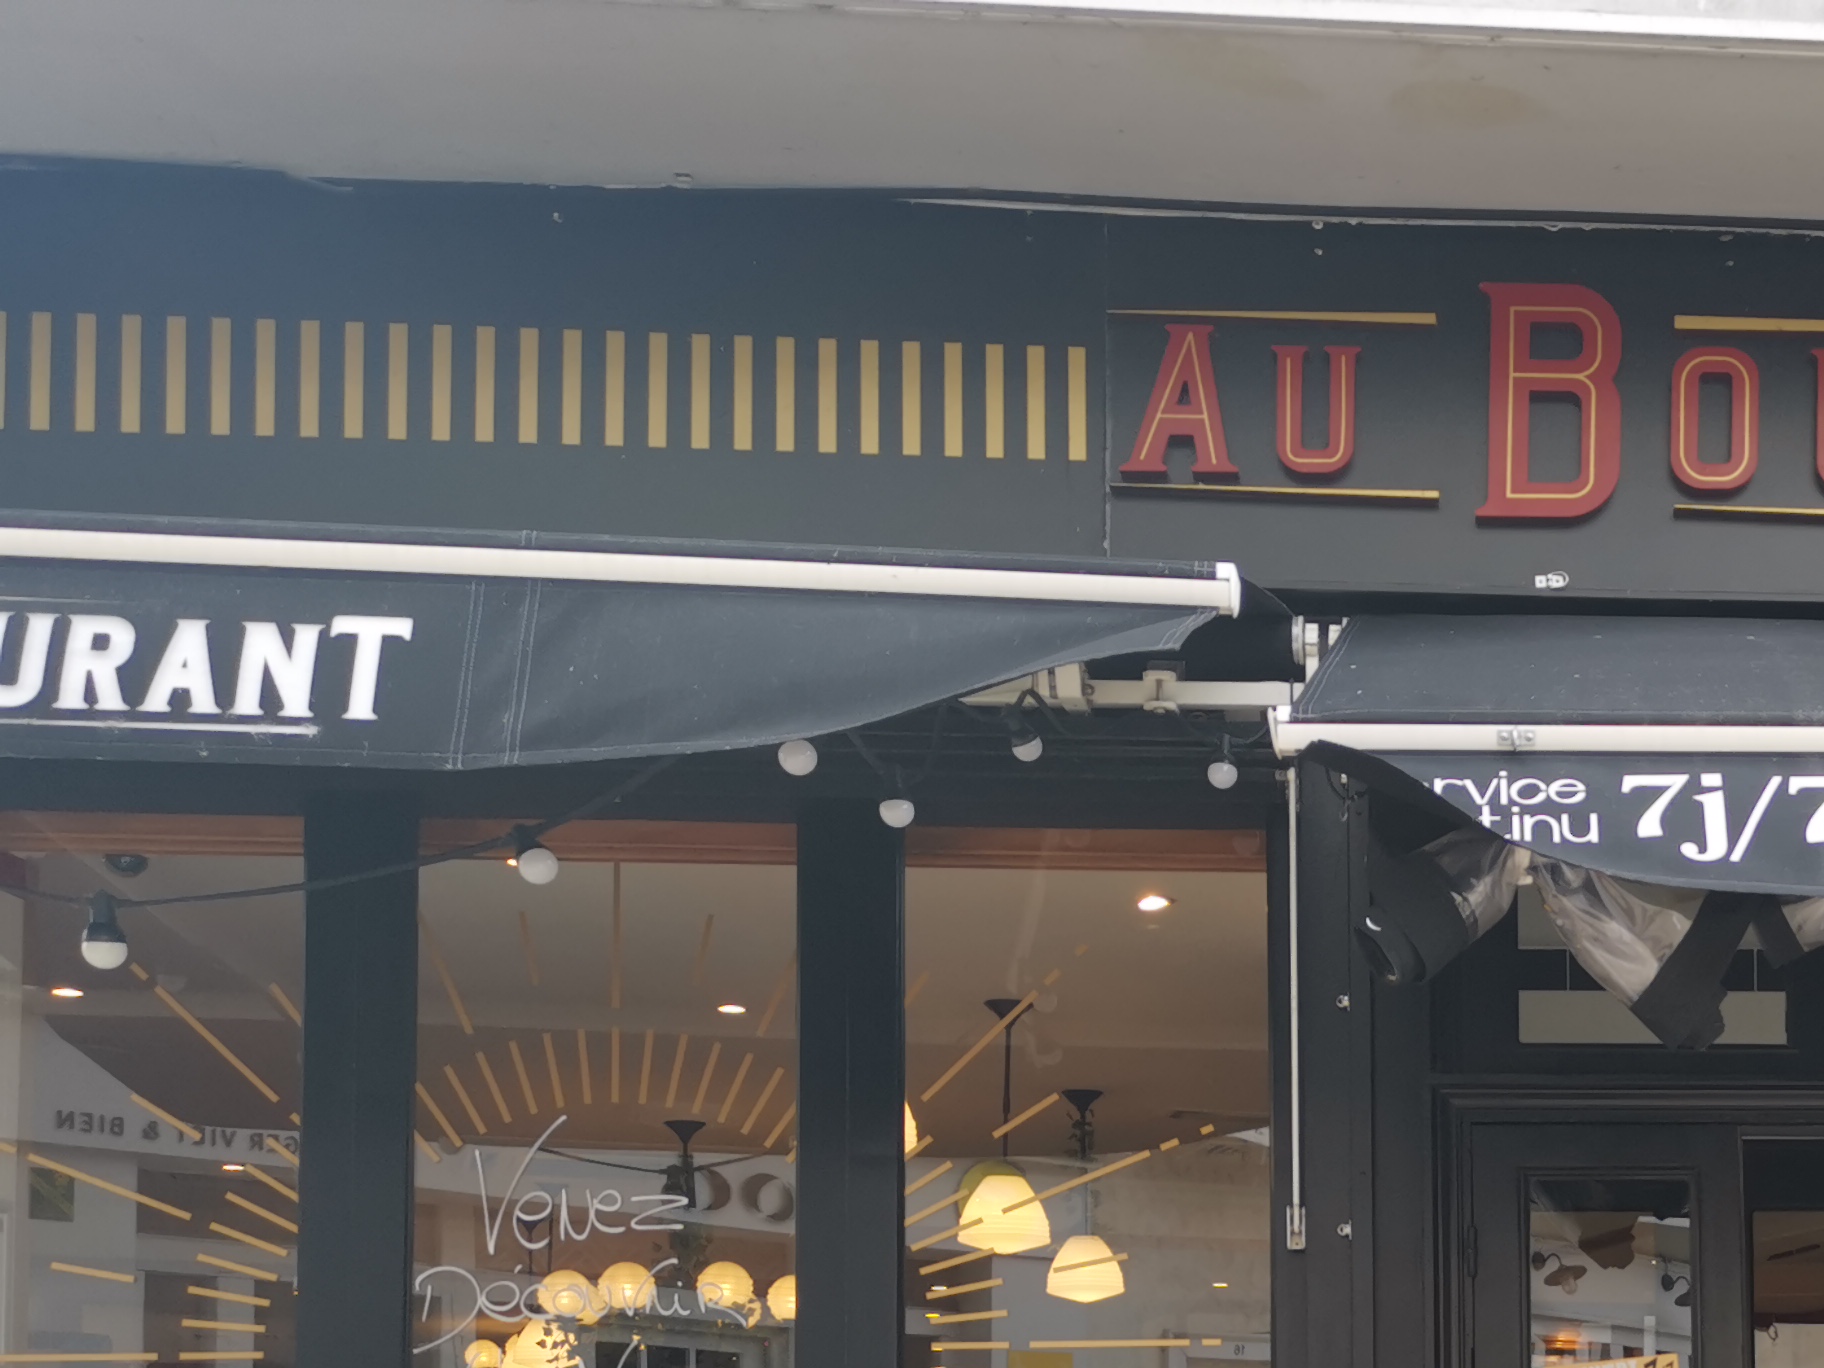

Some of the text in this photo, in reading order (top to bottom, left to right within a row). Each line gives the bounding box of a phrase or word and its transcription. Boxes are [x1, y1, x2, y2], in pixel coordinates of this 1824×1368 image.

[1119, 323, 1362, 476] AU
[1423, 770, 1587, 805] rvice
[474, 1114, 690, 1256] Venez
